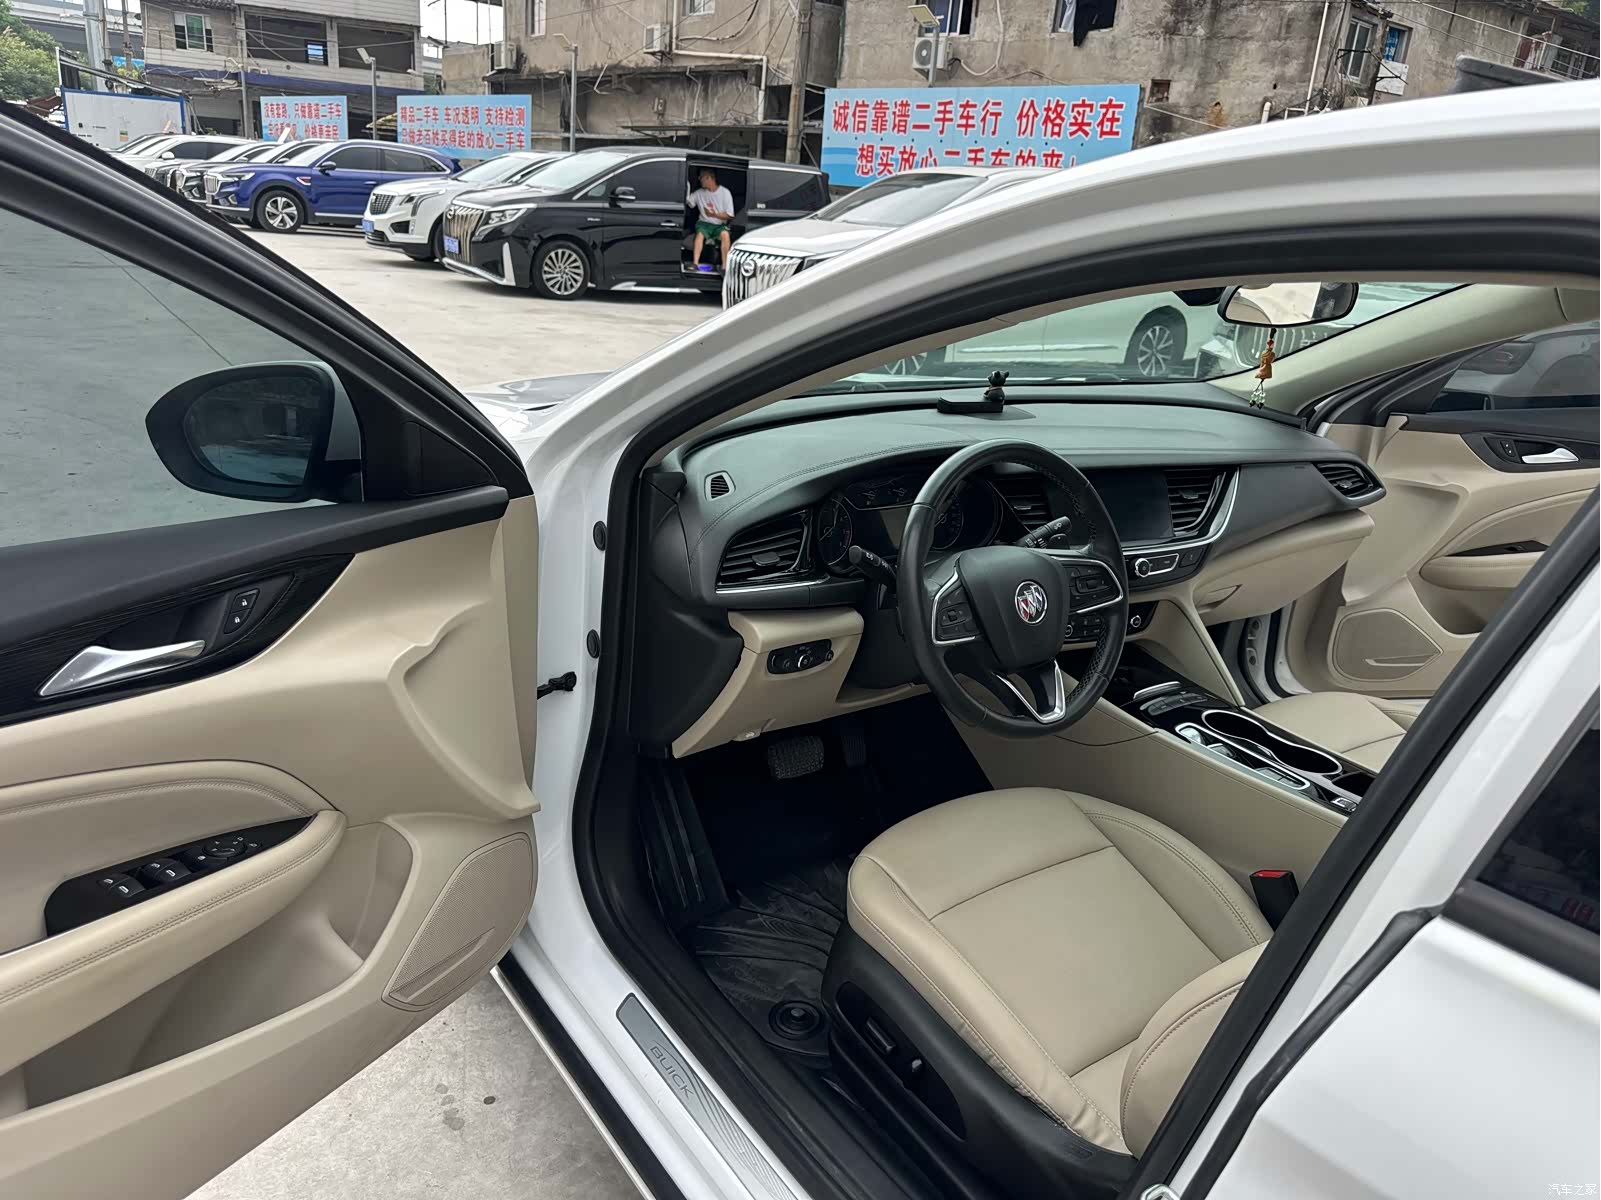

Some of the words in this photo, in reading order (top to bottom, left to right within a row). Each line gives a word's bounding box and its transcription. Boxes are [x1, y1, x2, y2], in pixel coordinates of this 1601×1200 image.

[400, 106, 439, 123] 精品二手车
[445, 106, 480, 124] 车况透明
[484, 106, 526, 127] 支持检测
[832, 98, 1002, 136] 诚信靠谱二手车行
[1016, 96, 1125, 138] 价格实在
[650, 1045, 694, 1099] BUICK
